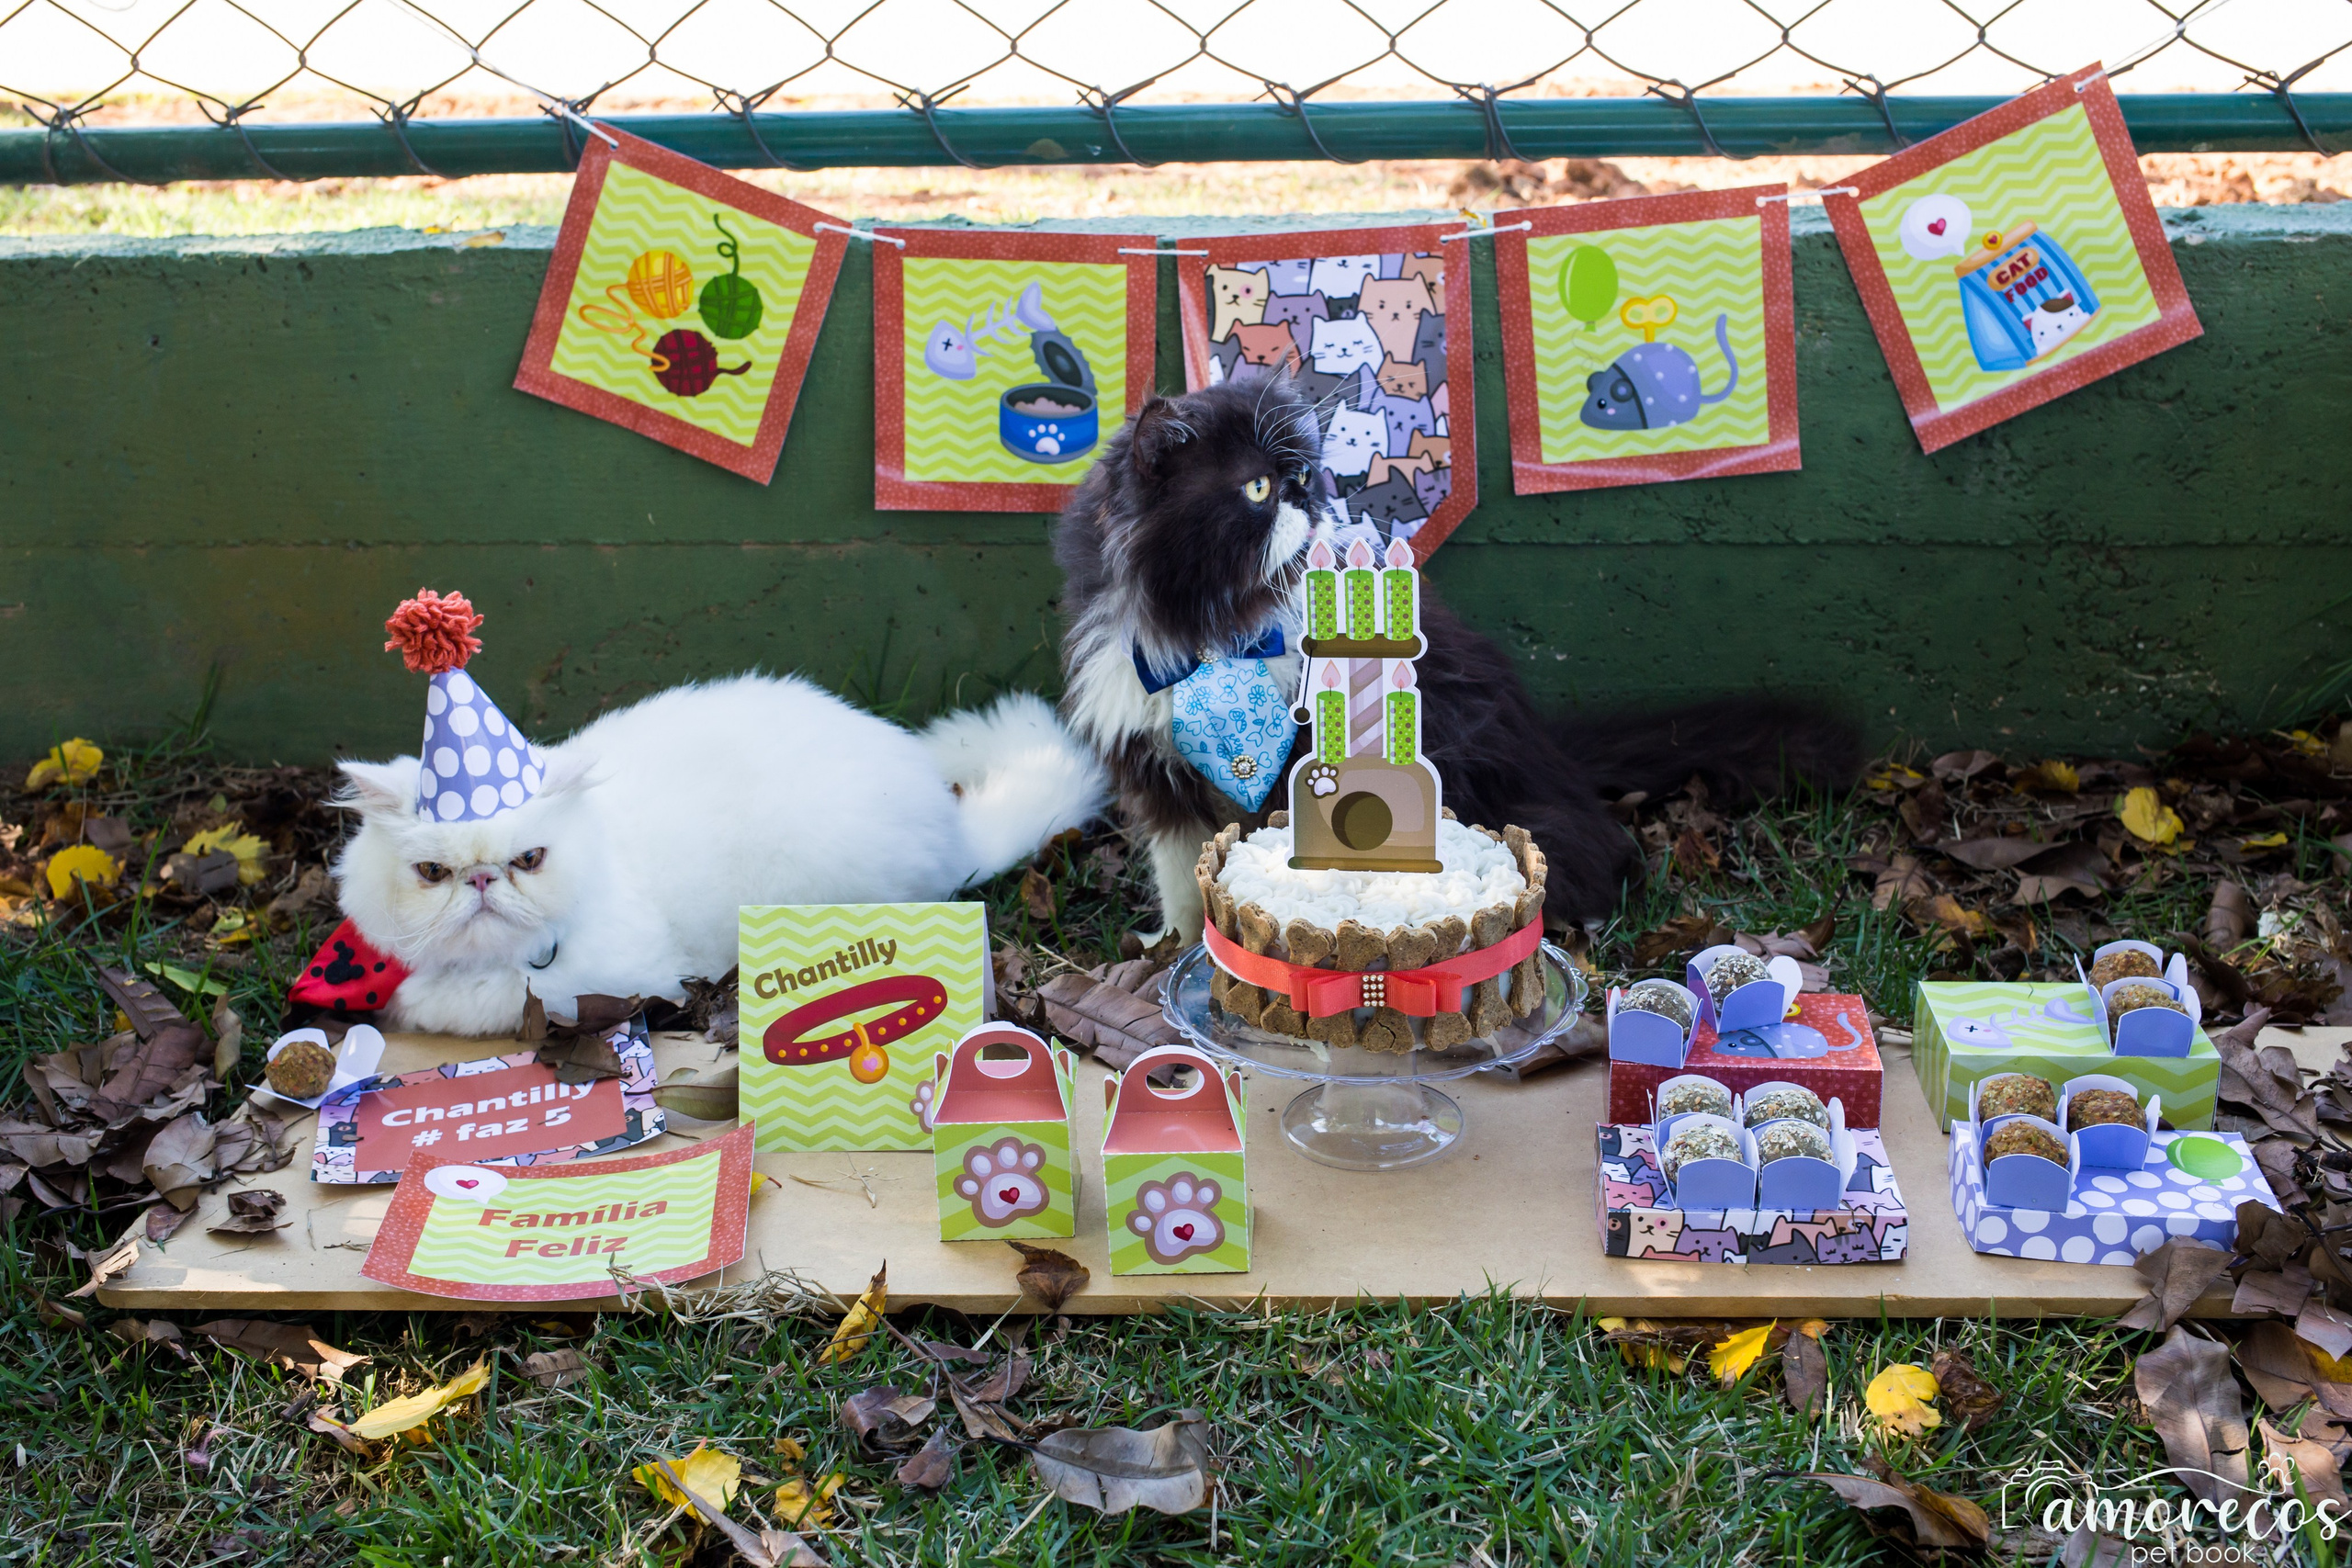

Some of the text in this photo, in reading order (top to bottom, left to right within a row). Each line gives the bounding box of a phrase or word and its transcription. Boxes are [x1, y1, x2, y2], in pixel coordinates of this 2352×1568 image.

[1996, 253, 2031, 285] CAT
[2004, 266, 2049, 304] FOOD
[753, 937, 897, 999] Chantilly
[381, 1078, 596, 1127] Chantilly
[412, 1106, 572, 1147] # faz 5
[478, 1200, 668, 1228] Família
[504, 1235, 628, 1258] Feliz
